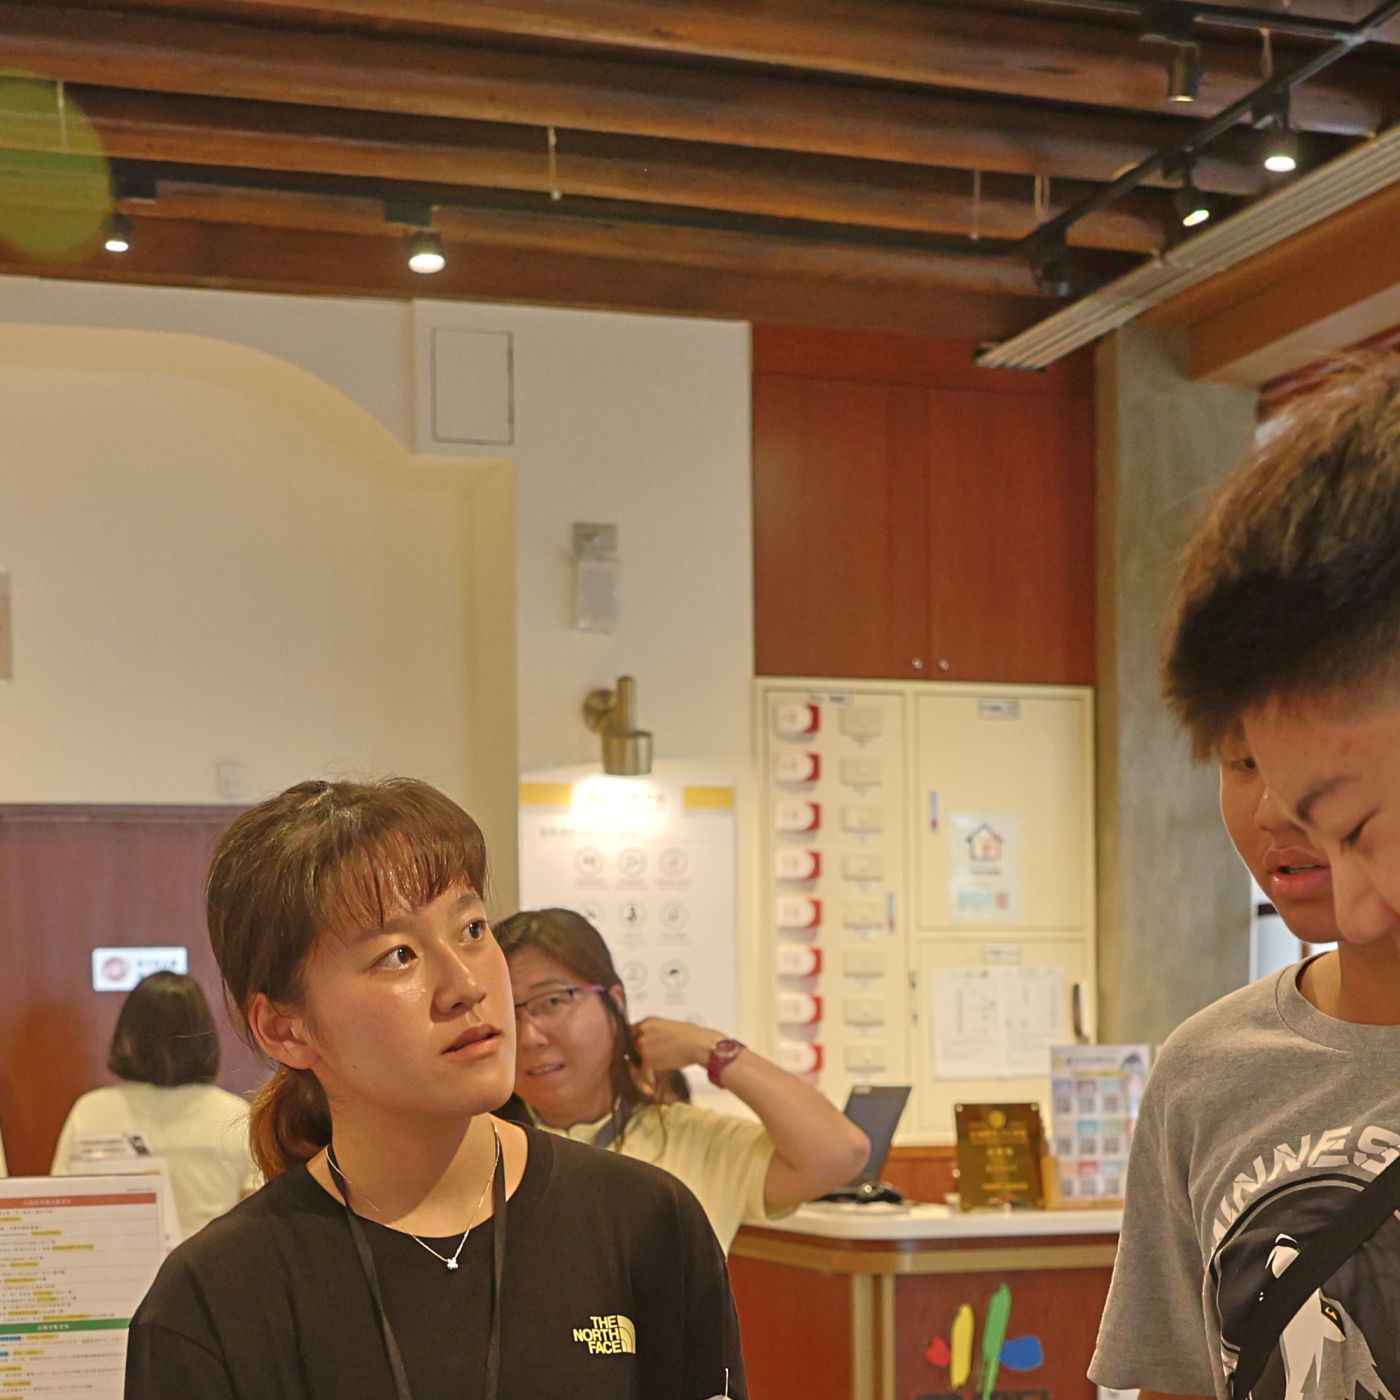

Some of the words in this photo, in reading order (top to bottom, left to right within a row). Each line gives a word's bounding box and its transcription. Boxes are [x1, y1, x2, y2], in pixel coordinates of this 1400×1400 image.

[589, 1315, 617, 1329] THE
[572, 1328, 620, 1342] NORTH
[588, 1340, 622, 1354] FACE
